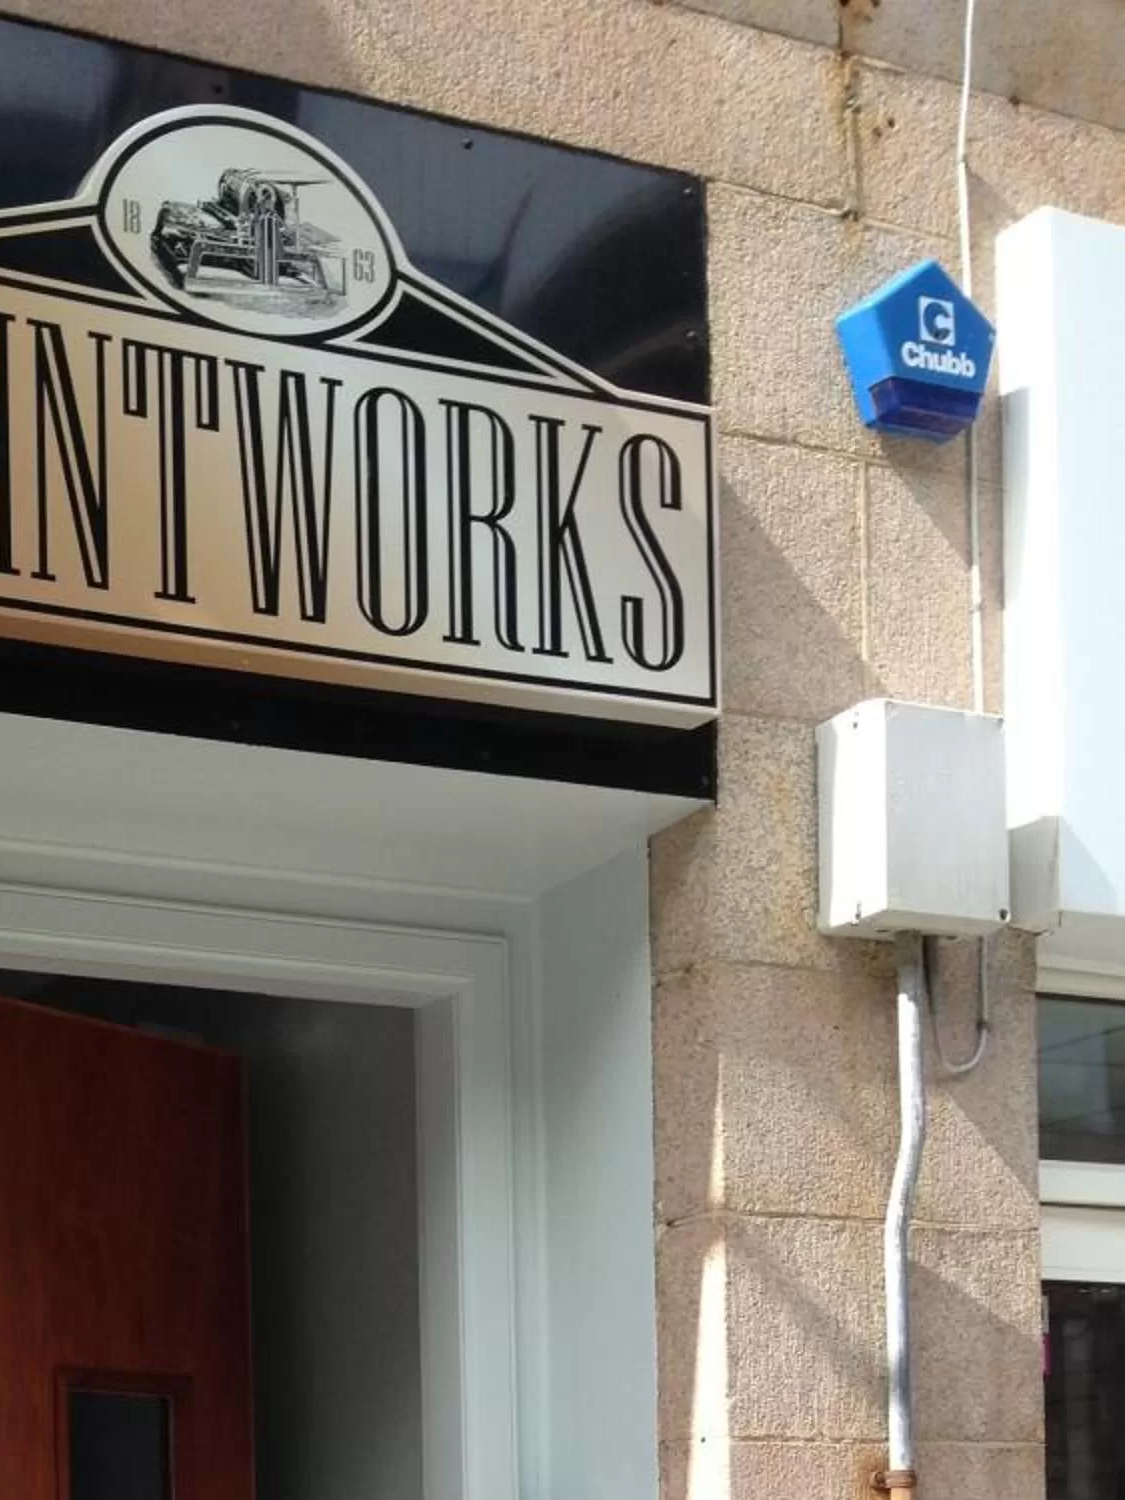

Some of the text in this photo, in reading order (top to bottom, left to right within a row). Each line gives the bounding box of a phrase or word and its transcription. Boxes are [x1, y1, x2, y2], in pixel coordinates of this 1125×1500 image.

[123, 198, 141, 234] 18
[353, 248, 375, 283] 63
[901, 340, 976, 378] Chubb
